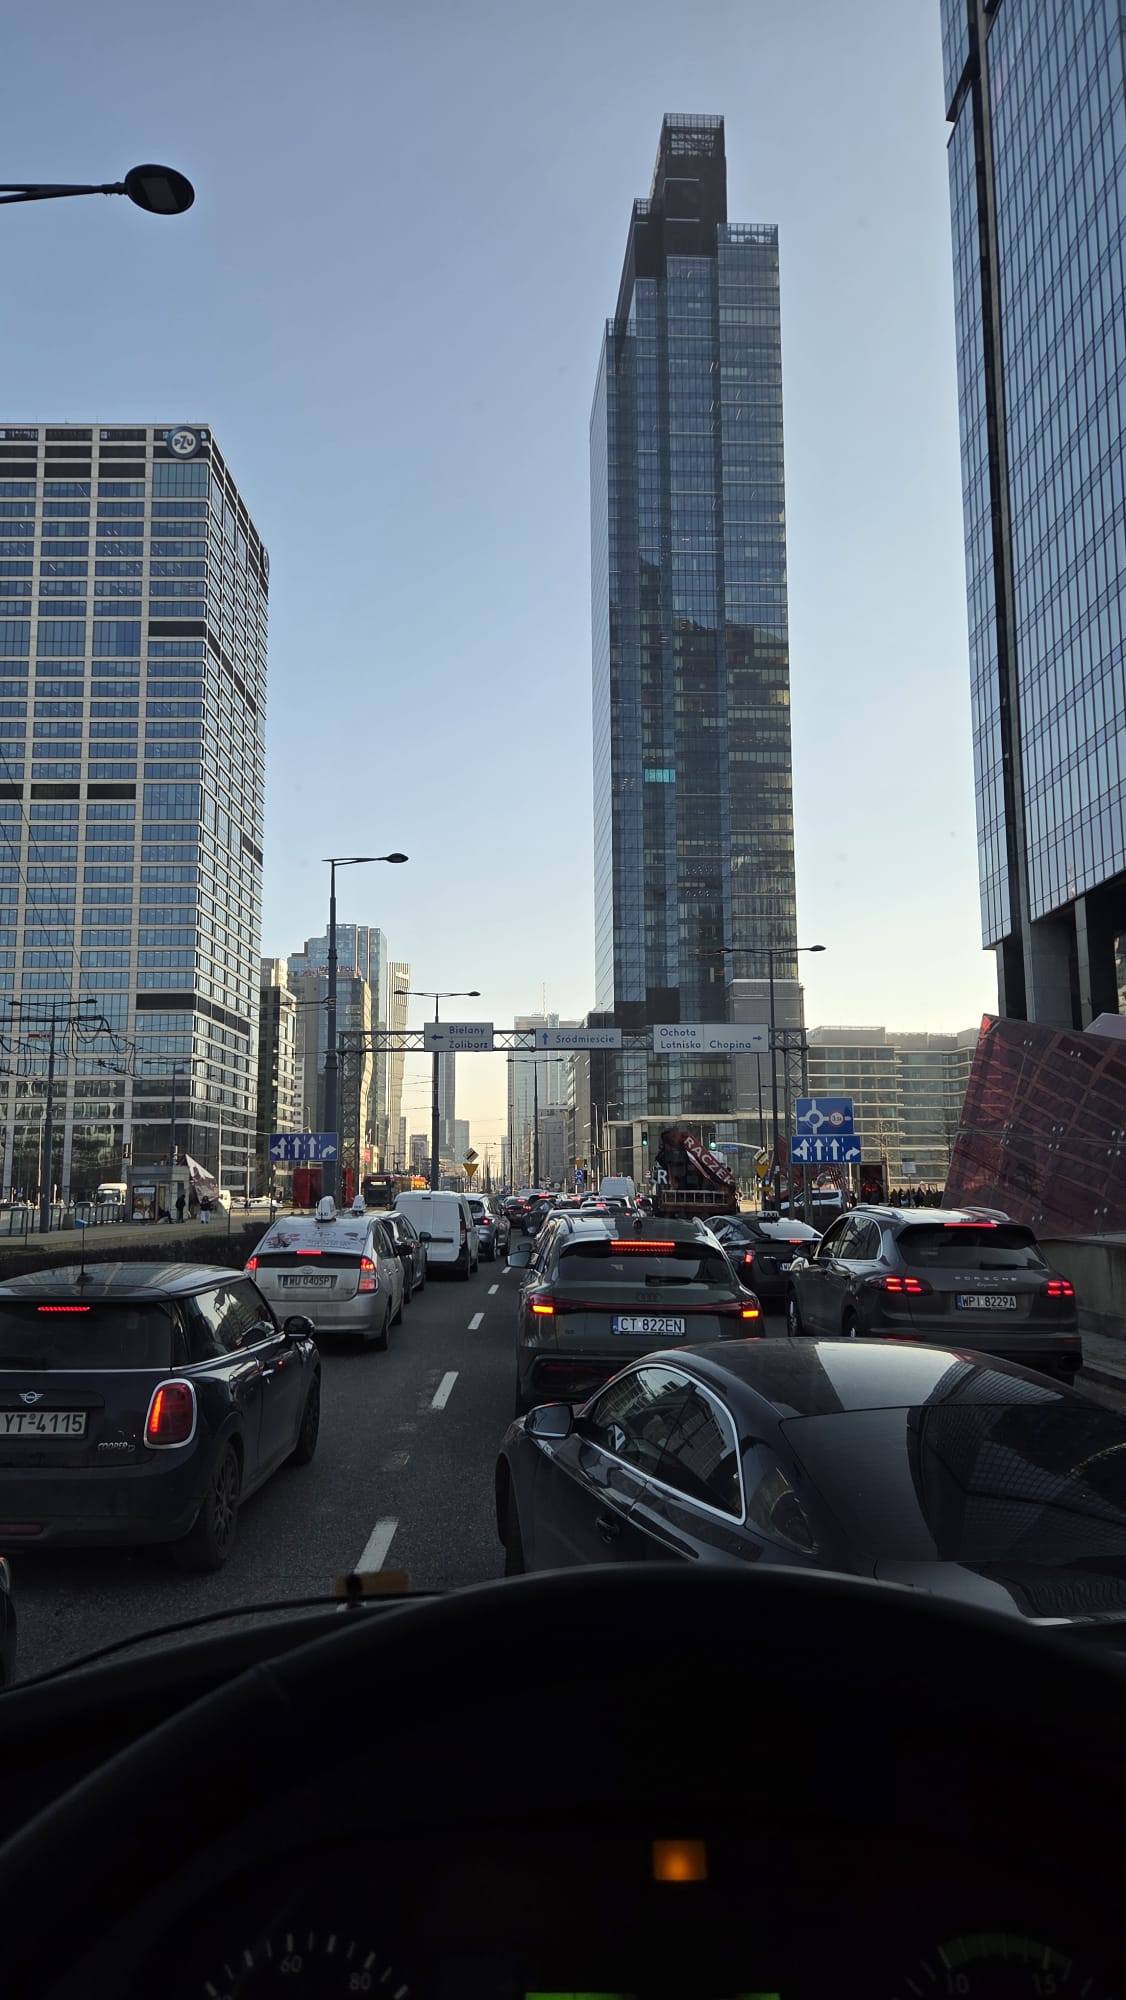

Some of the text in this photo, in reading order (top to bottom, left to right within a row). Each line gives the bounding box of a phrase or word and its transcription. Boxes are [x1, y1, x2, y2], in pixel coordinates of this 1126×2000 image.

[174, 435, 194, 450] PZU
[449, 1025, 485, 1035] Bielany
[660, 1028, 696, 1037] Ochota
[660, 1040, 752, 1051] Lotnisko Chopina
[683, 1136, 733, 1185] RACZEK
[621, 1318, 682, 1332] CT 822EN
[280, 1955, 303, 1973] 60
[349, 1972, 372, 1990] 80
